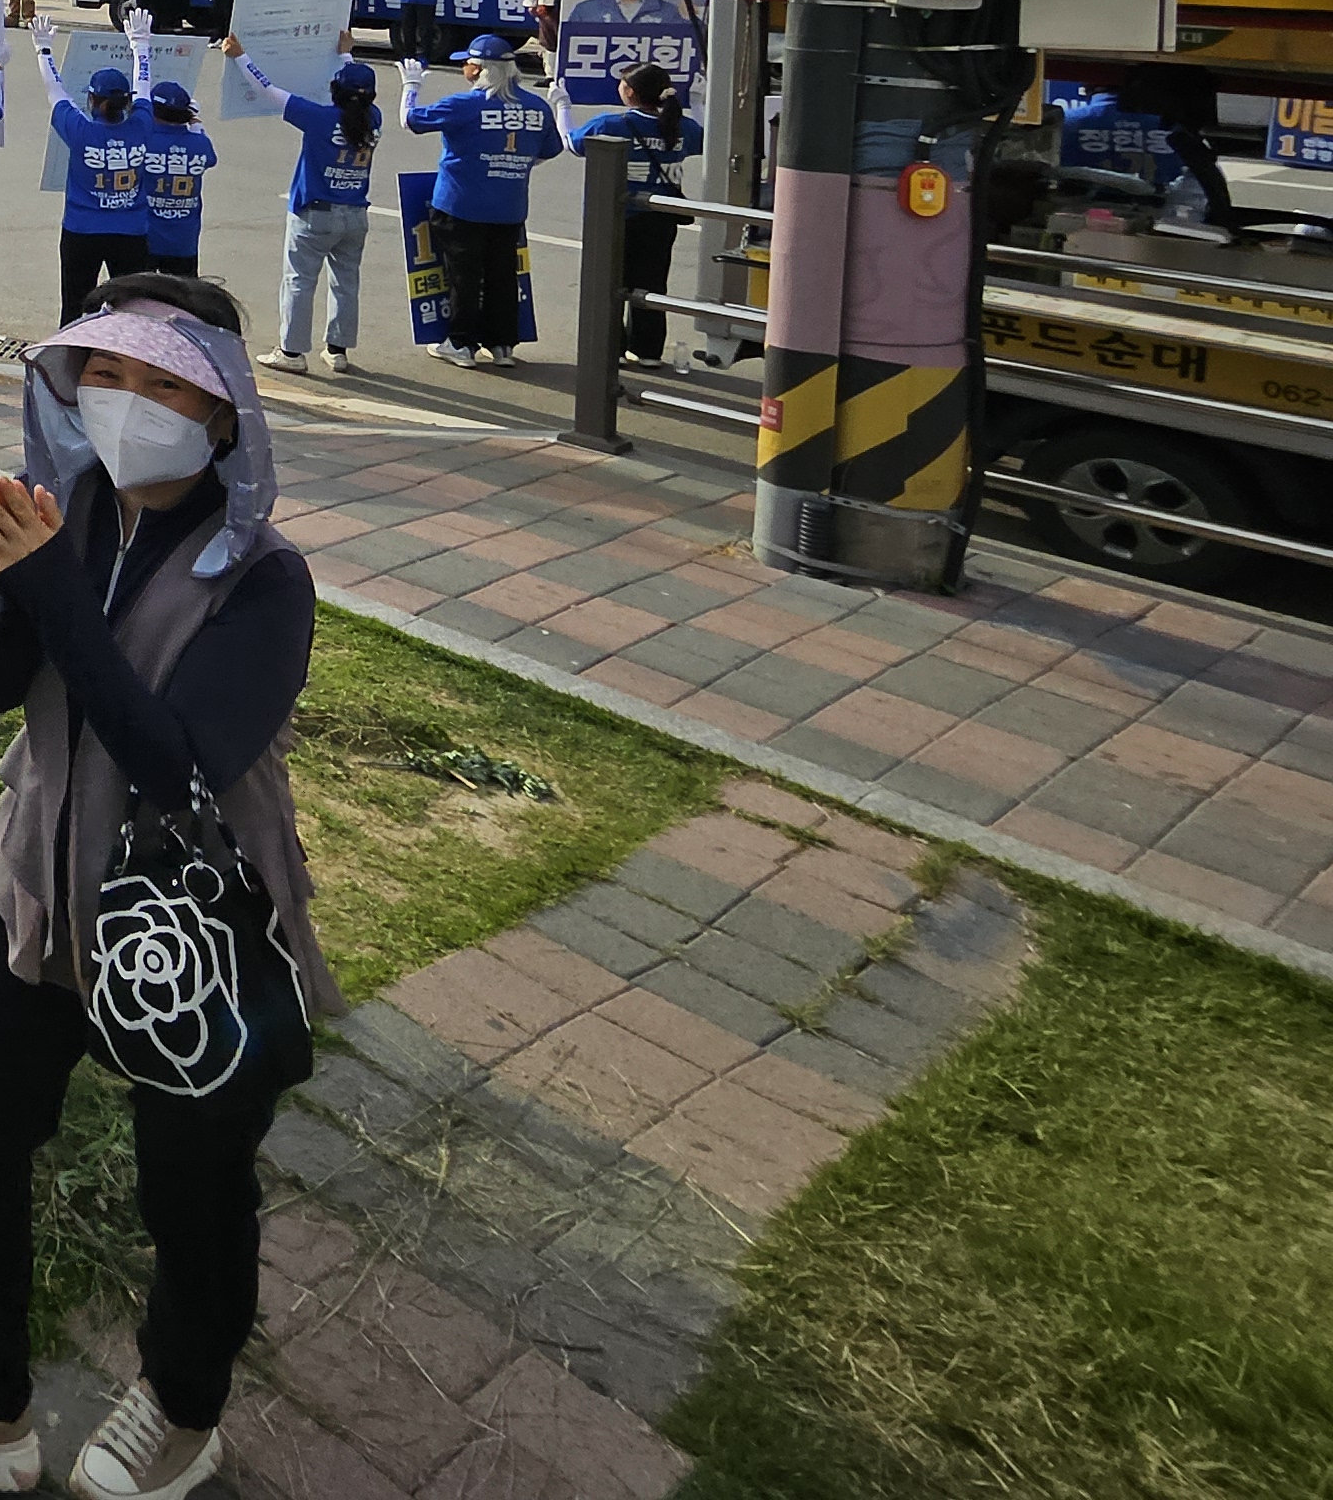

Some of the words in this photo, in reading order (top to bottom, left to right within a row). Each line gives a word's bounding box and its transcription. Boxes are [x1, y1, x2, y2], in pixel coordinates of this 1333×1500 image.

[564, 35, 696, 83] 모정환
[480, 109, 545, 132] 모정환
[503, 132, 517, 152] 1
[1277, 134, 1297, 157] 1
[84, 144, 147, 170] 정철성
[144, 152, 208, 175] 정철성
[412, 220, 437, 266] 1
